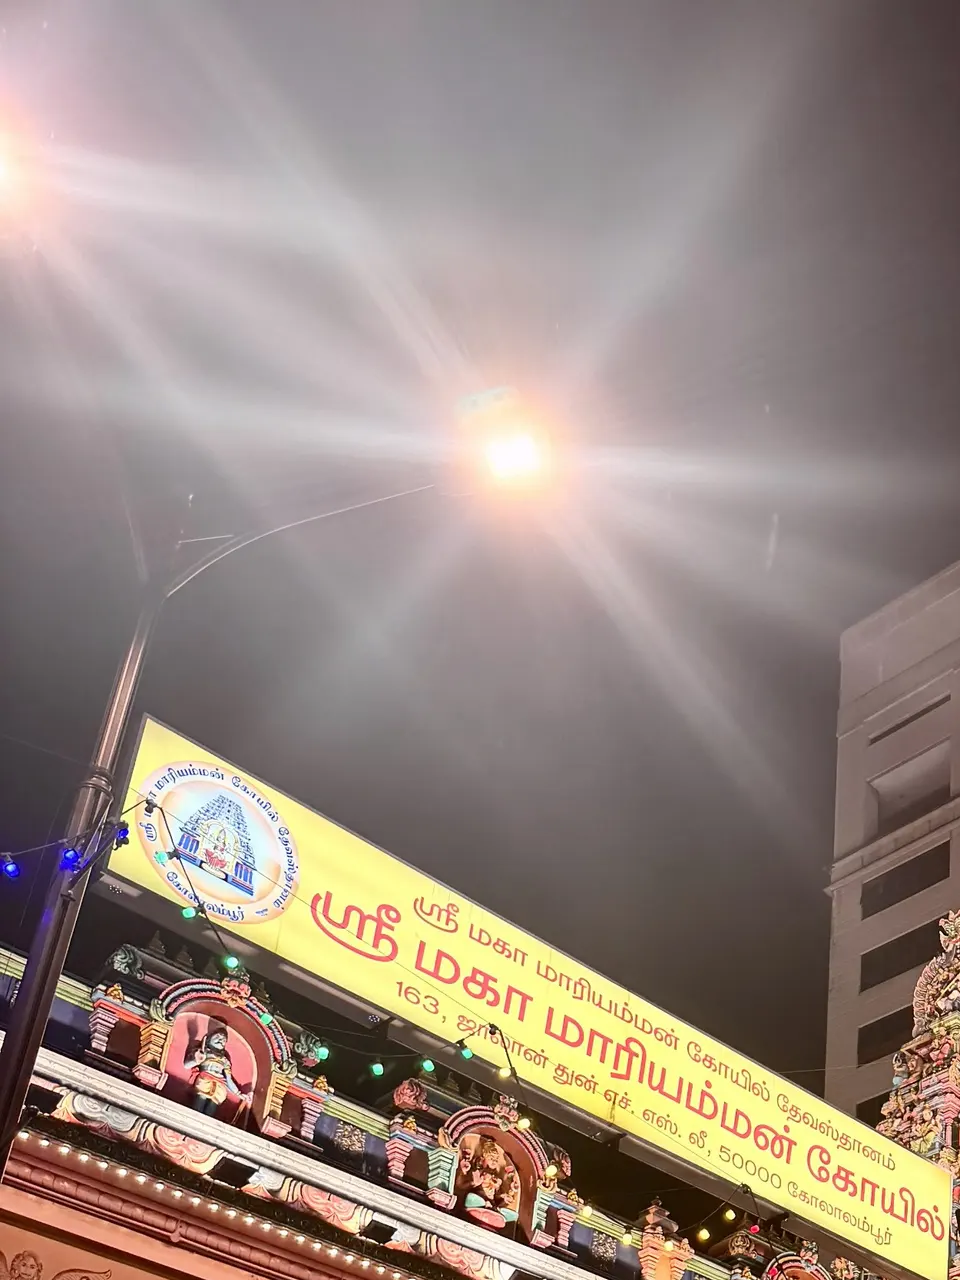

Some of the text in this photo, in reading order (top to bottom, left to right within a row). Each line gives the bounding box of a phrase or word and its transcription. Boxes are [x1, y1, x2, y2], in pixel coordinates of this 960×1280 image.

[155, 763, 225, 791] மாரியம்மன்
[231, 776, 279, 823] கோயில்
[273, 826, 299, 911] தேவஸ்தானம்
[310, 891, 945, 1241] ஸ்ரீ மகா மாரியம்மன் கோயில்
[413, 896, 896, 1171] ஸ்ரீ மகா மாரியம்மன் கோயில் தேவஸ்தானம்
[553, 1062, 599, 1095] துன்
[719, 1145, 782, 1189] 50000
[787, 1180, 893, 1246] கோலாலம்பூர்
